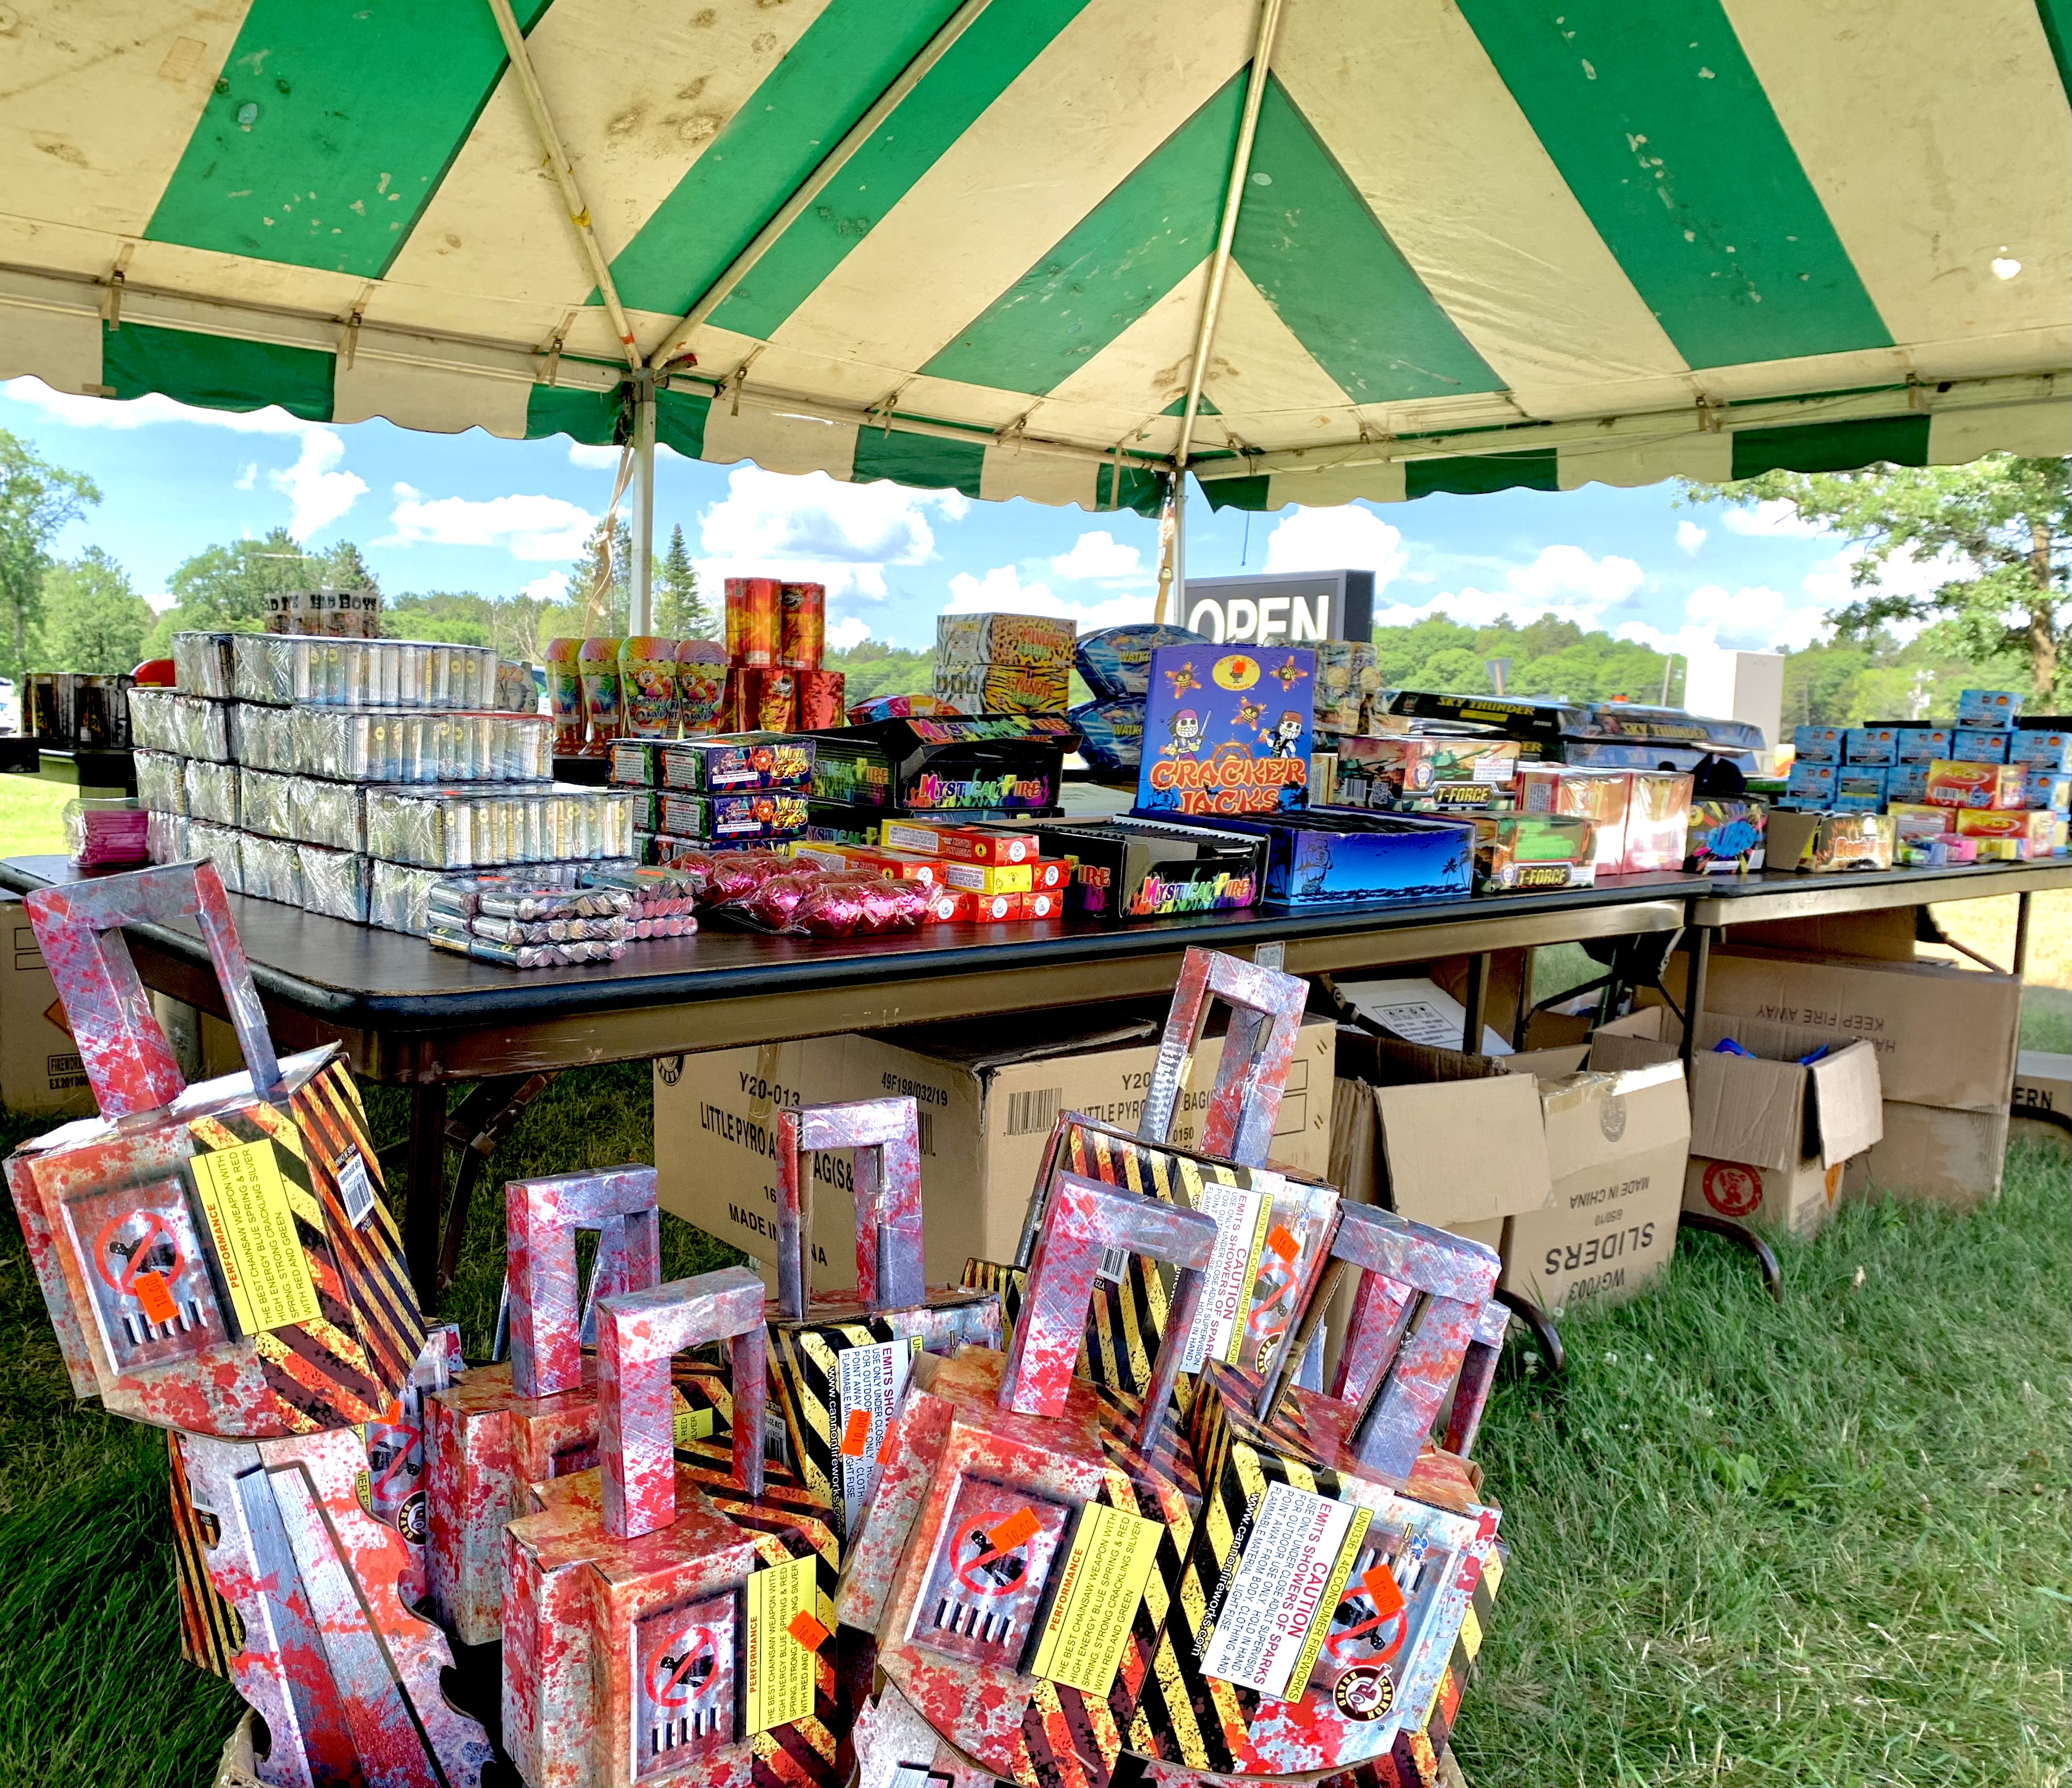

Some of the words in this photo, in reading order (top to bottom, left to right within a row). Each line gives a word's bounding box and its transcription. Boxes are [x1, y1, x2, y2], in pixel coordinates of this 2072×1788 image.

[1189, 595, 1330, 643] OPEN
[1437, 697, 1463, 707] SKY
[1468, 701, 1536, 717] THUNDER
[907, 718, 1011, 744] MYSTICAL
[1006, 715, 1072, 733] FIRE
[1622, 722, 1648, 736] SKY
[1651, 724, 1710, 740] THUNDER
[778, 746, 805, 760] MINI
[814, 760, 855, 784] STICAL
[1150, 757, 1307, 791] CRACKER
[920, 775, 1000, 801] MYSTICAL
[997, 774, 1041, 799] FIRE
[1179, 787, 1280, 815] JACKS
[1437, 787, 1490, 804] T-FORCE
[779, 796, 805, 811] MINI
[808, 825, 861, 844] YSTICAL
[1142, 875, 1215, 906] MYSTICAL
[1214, 872, 1250, 896] FIRE
[1518, 869, 1567, 885] T-FORCE
[1755, 1005, 1798, 1023] AWAY
[1803, 1009, 1837, 1026] FIRE
[1843, 1015, 1885, 1031] KEEP
[738, 1071, 800, 1107] Y20-013
[881, 1071, 948, 1107] 49F198/032/19
[700, 1102, 735, 1143] LITTLE
[736, 1113, 766, 1157] PYRO
[215, 1155, 229, 1180] WITH
[228, 1151, 242, 1172] RED
[242, 1149, 258, 1182] SILVER
[1570, 1189, 1606, 1209] CHINA
[1608, 1185, 1620, 1200] IN
[1621, 1177, 1651, 1197] MADE
[223, 1181, 243, 1225] WEAPON
[238, 1184, 257, 1223] SPRING
[252, 1184, 275, 1238] CRACKLING
[1257, 1196, 1270, 1231] UN0336
[274, 1212, 291, 1246] GREEN
[729, 1203, 765, 1237] MADE
[206, 1203, 239, 1288] PERFORMANCE
[236, 1226, 260, 1277] CHAINSAW
[251, 1225, 265, 1251] BLUE
[1545, 1222, 1655, 1275] SLIDERS
[269, 1239, 288, 1280] STRONG
[285, 1247, 298, 1268] AND
[259, 1253, 278, 1294] ENERGY
[291, 1269, 304, 1289] RED
[1222, 1248, 1247, 1320] CAUTION
[1239, 1258, 1257, 1314] CONSUMER
[252, 1278, 267, 1304] BEST
[281, 1281, 300, 1318] SPRING,
[298, 1291, 312, 1316] WITH
[261, 1306, 274, 1324] THE
[273, 1297, 287, 1321] HIGH
[1228, 1317, 1245, 1363] FIREWOR
[883, 1347, 893, 1385] EMITS
[1258, 1340, 1272, 1375] BRAND
[841, 1353, 851, 1401] FLAMMABLE
[828, 1366, 844, 1533] www.cannonfireworks.com
[1255, 1486, 1282, 1536] FLAMMABLE
[1276, 1489, 1294, 1518] POINT
[1291, 1494, 1306, 1512] FOR
[1304, 1498, 1318, 1515] USE
[400, 1504, 414, 1539] BRAND
[1265, 1519, 1283, 1546] AWAY
[1273, 1514, 1298, 1559] OUTDOOR
[1295, 1516, 1311, 1539] ONLY
[1307, 1502, 1332, 1543] EMITS
[1345, 1510, 1370, 1550] UN0336
[1254, 1547, 1272, 1575] FROM
[1283, 1538, 1302, 1569] UNDER
[1336, 1551, 1354, 1575] 1.4G
[1190, 1492, 1260, 1658] www.cannonfireworks.com
[1266, 1560, 1280, 1579] USE
[1272, 1569, 1291, 1598] CLOSE
[1281, 1544, 1316, 1610] SHOWERS
[1049, 1547, 1083, 1631] PERFORMANCE
[1056, 1660, 1069, 1679] THE
[1063, 1634, 1078, 1658] BEST
[1071, 1582, 1094, 1632] CHAINSAW
[1088, 1538, 1108, 1581] WEAPON
[1103, 1512, 1117, 1537] WITH
[1069, 1658, 1083, 1683] HIGH
[1078, 1615, 1097, 1656] ENERGY
[1092, 1588, 1106, 1614] BLUE
[1101, 1549, 1119, 1586] SPRING
[1117, 1516, 1130, 1537] RED
[1081, 1650, 1101, 1687] SPRING,
[1094, 1609, 1113, 1648] STRONG
[1107, 1554, 1131, 1608] CRACKLING
[1125, 1521, 1142, 1554] SILVER
[1227, 1583, 1244, 1608] LIGHT
[1242, 1575, 1261, 1604] BODY,
[1256, 1580, 1273, 1606] ONLY.
[1286, 1560, 1329, 1638] CAUTION
[1218, 1608, 1235, 1633] FUSE.
[1262, 1597, 1280, 1624] ADULT
[1312, 1575, 1344, 1637] CONSUMER
[1244, 1609, 1262, 1634] HOLD
[1273, 1612, 1289, 1631] OF
[1094, 1666, 1108, 1691] WITH
[1102, 1645, 1116, 1666] RED
[1109, 1624, 1122, 1645] AND
[1116, 1589, 1134, 1623] GREEN
[1240, 1635, 1251, 1646] IN
[1240, 1624, 1269, 1681] SUPERVISION.
[1216, 1654, 1231, 1674] AND
[1230, 1646, 1247, 1672] HAND
[1252, 1634, 1281, 1685] SPARKS
[1287, 1637, 1320, 1700] FIREWORKS
[1337, 1671, 1358, 1706] BRAND
[1367, 1678, 1392, 1719] CANNON
